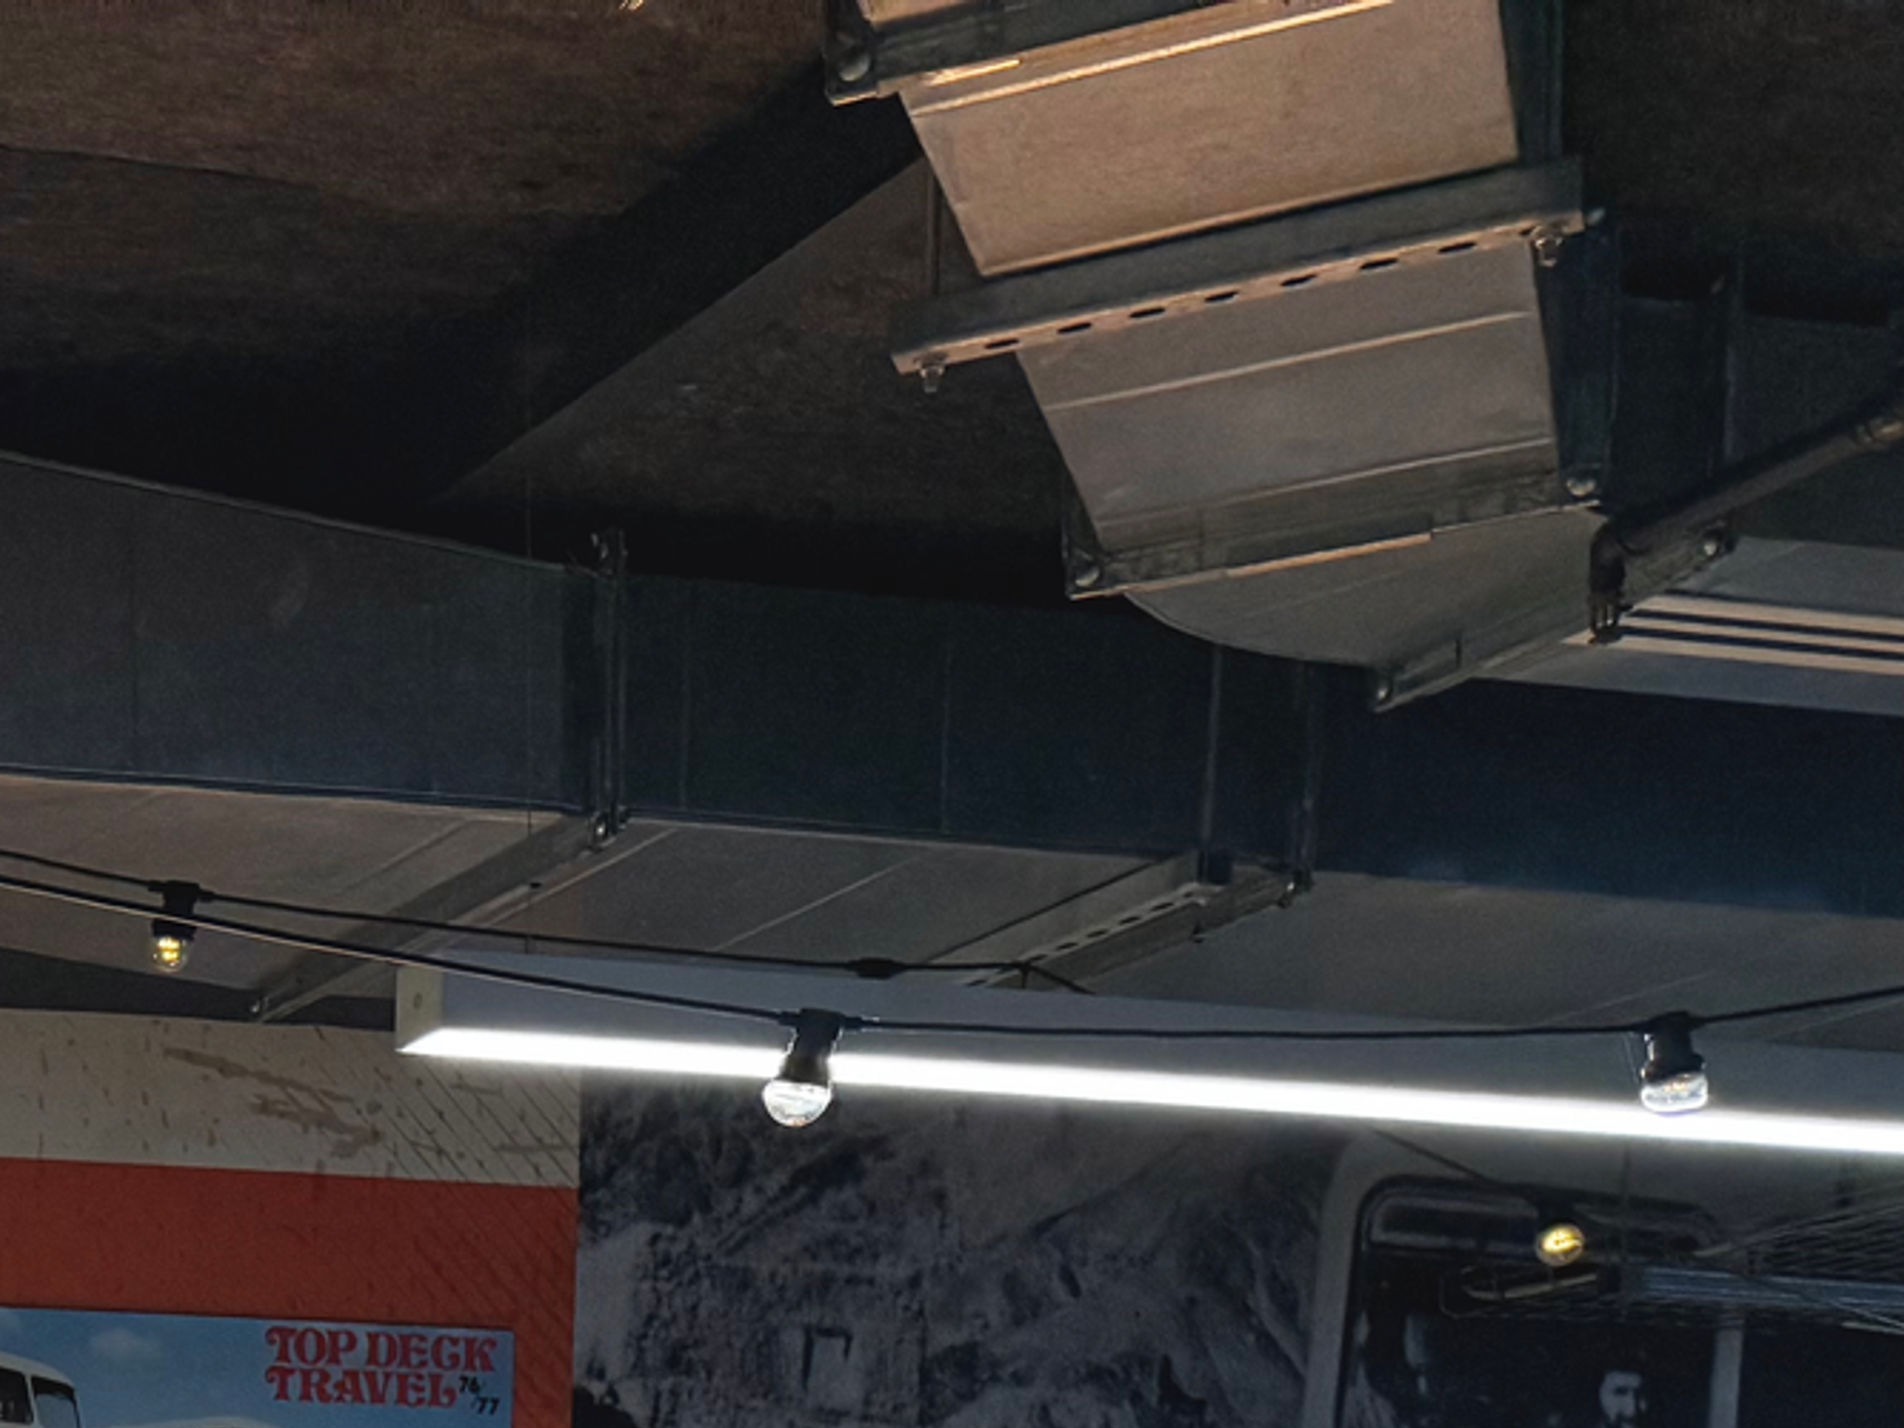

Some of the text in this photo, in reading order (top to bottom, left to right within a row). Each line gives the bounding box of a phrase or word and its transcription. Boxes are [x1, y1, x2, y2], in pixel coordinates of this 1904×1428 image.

[265, 1325, 498, 1373] TOP DECK
[265, 1366, 457, 1409] TRAVEL
